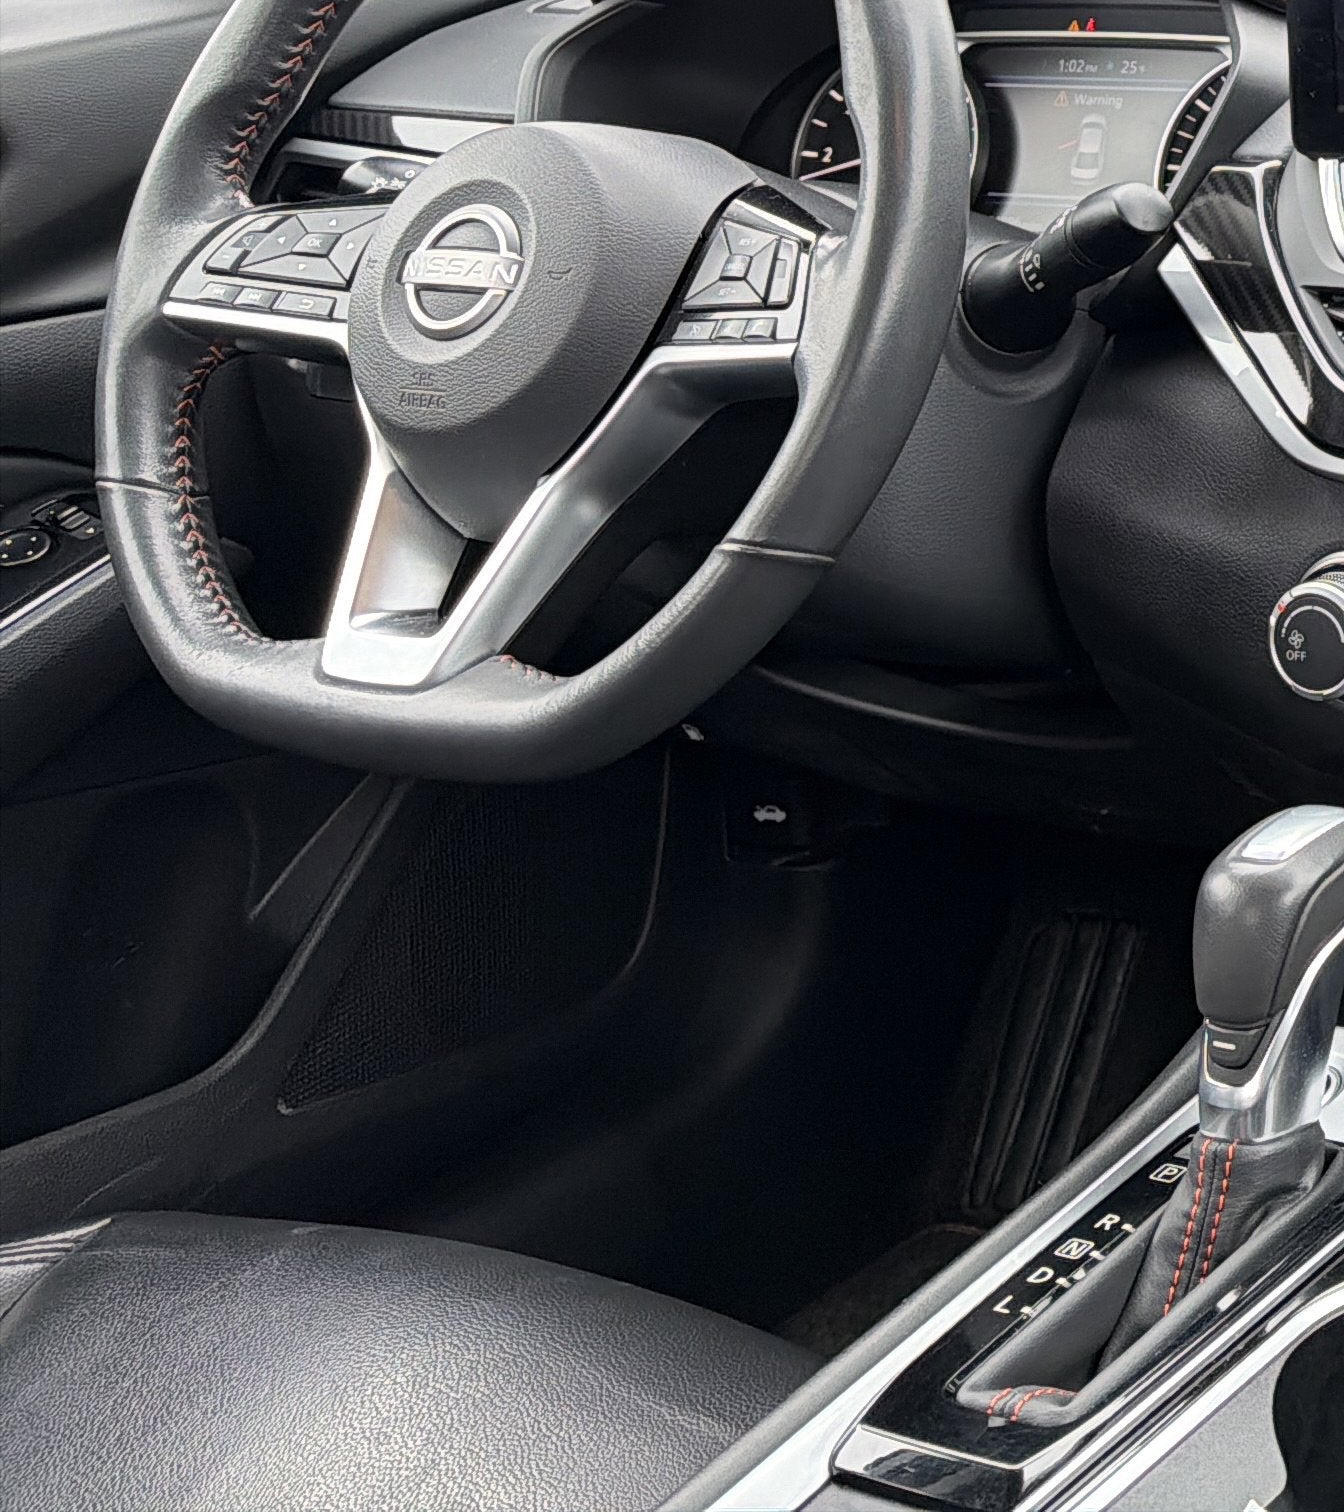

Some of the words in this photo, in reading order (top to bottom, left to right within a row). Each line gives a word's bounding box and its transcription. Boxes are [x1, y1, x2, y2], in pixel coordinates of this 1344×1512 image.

[1074, 93, 1124, 109] Warning
[821, 146, 833, 163] 2
[307, 238, 322, 248] OK
[403, 257, 518, 284] NISSAN
[1286, 651, 1307, 662] OFF
[1094, 1213, 1121, 1231] R
[1026, 1266, 1055, 1284] D
[993, 1294, 1014, 1314] L
